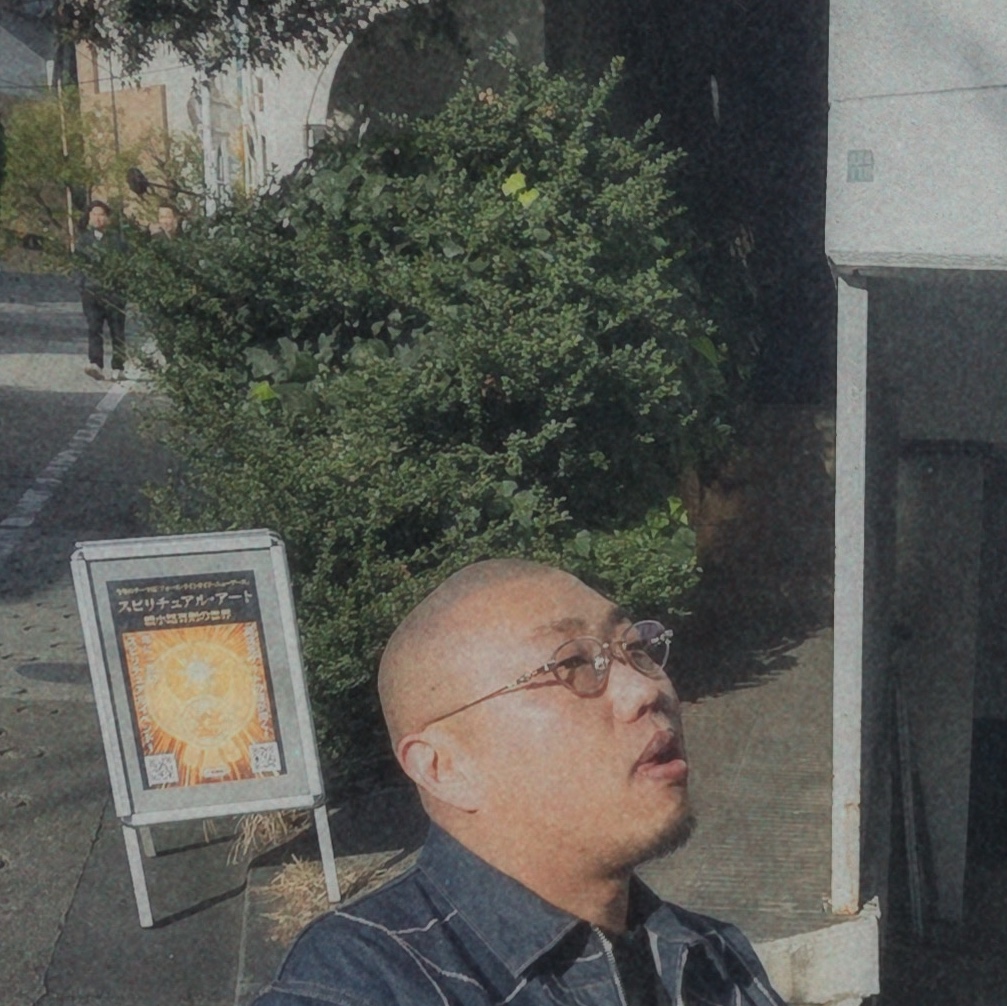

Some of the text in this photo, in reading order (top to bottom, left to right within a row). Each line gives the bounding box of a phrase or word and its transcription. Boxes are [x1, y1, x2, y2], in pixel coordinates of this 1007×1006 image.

[118, 590, 253, 613] スピリチュアル・アート
